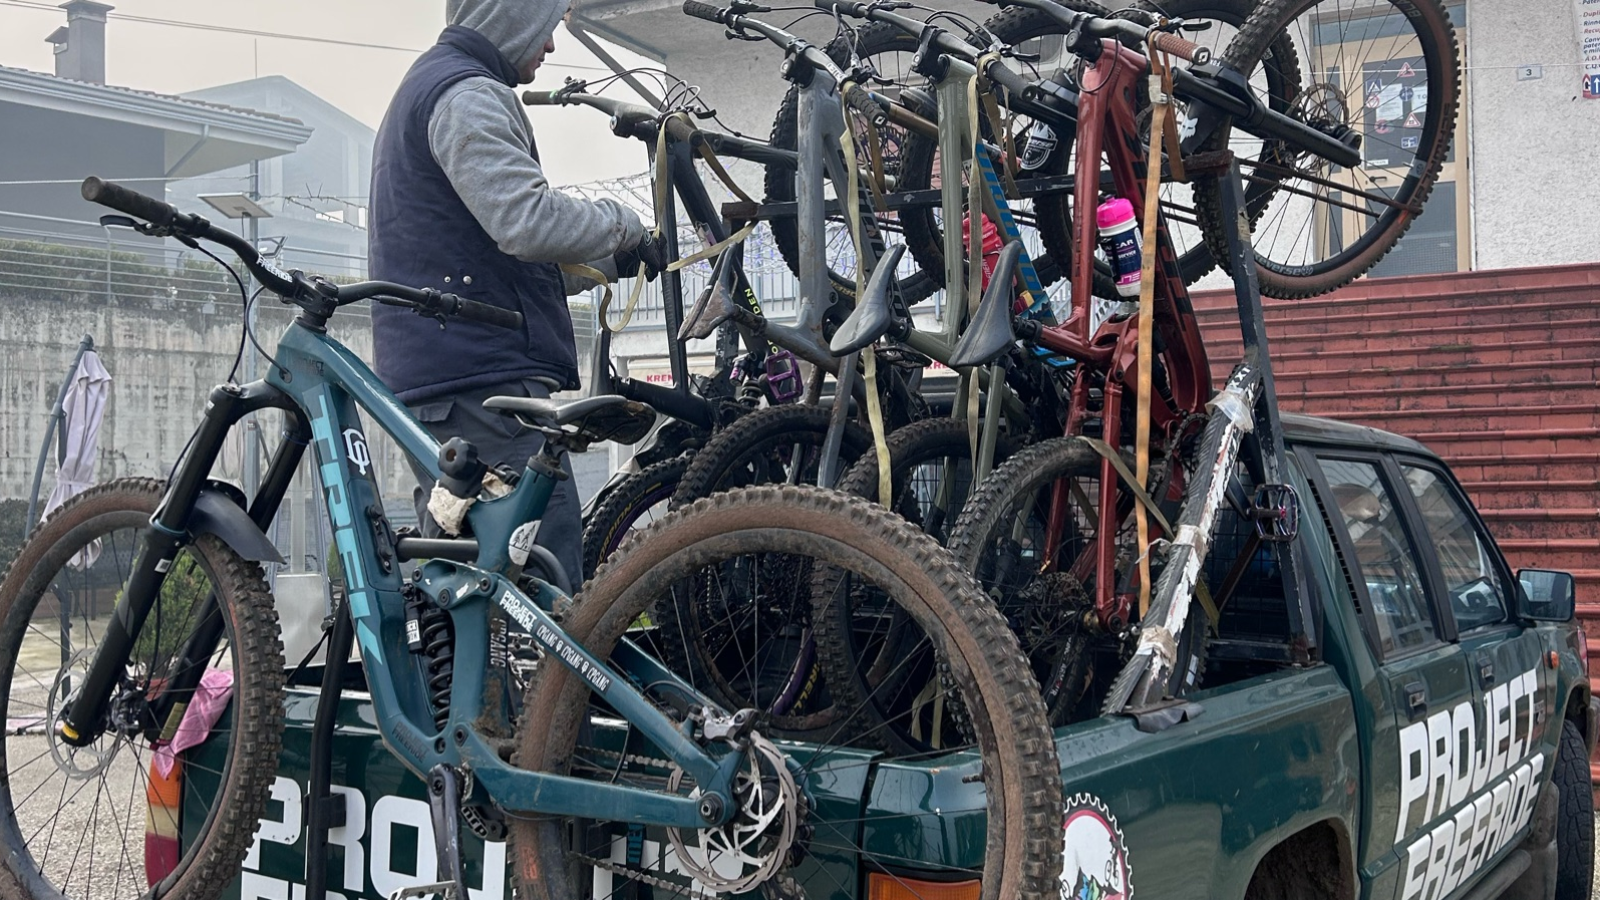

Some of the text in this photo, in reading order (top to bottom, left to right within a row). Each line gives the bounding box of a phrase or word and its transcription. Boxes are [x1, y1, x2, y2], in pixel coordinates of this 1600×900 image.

[1526, 68, 1532, 76] 3
[502, 590, 538, 625] PROJECT
[536, 624, 610, 692] CPGANG CPGANG CPGANG
[1394, 668, 1538, 845] PROJECT
[1401, 752, 1544, 900] FREERIDE
